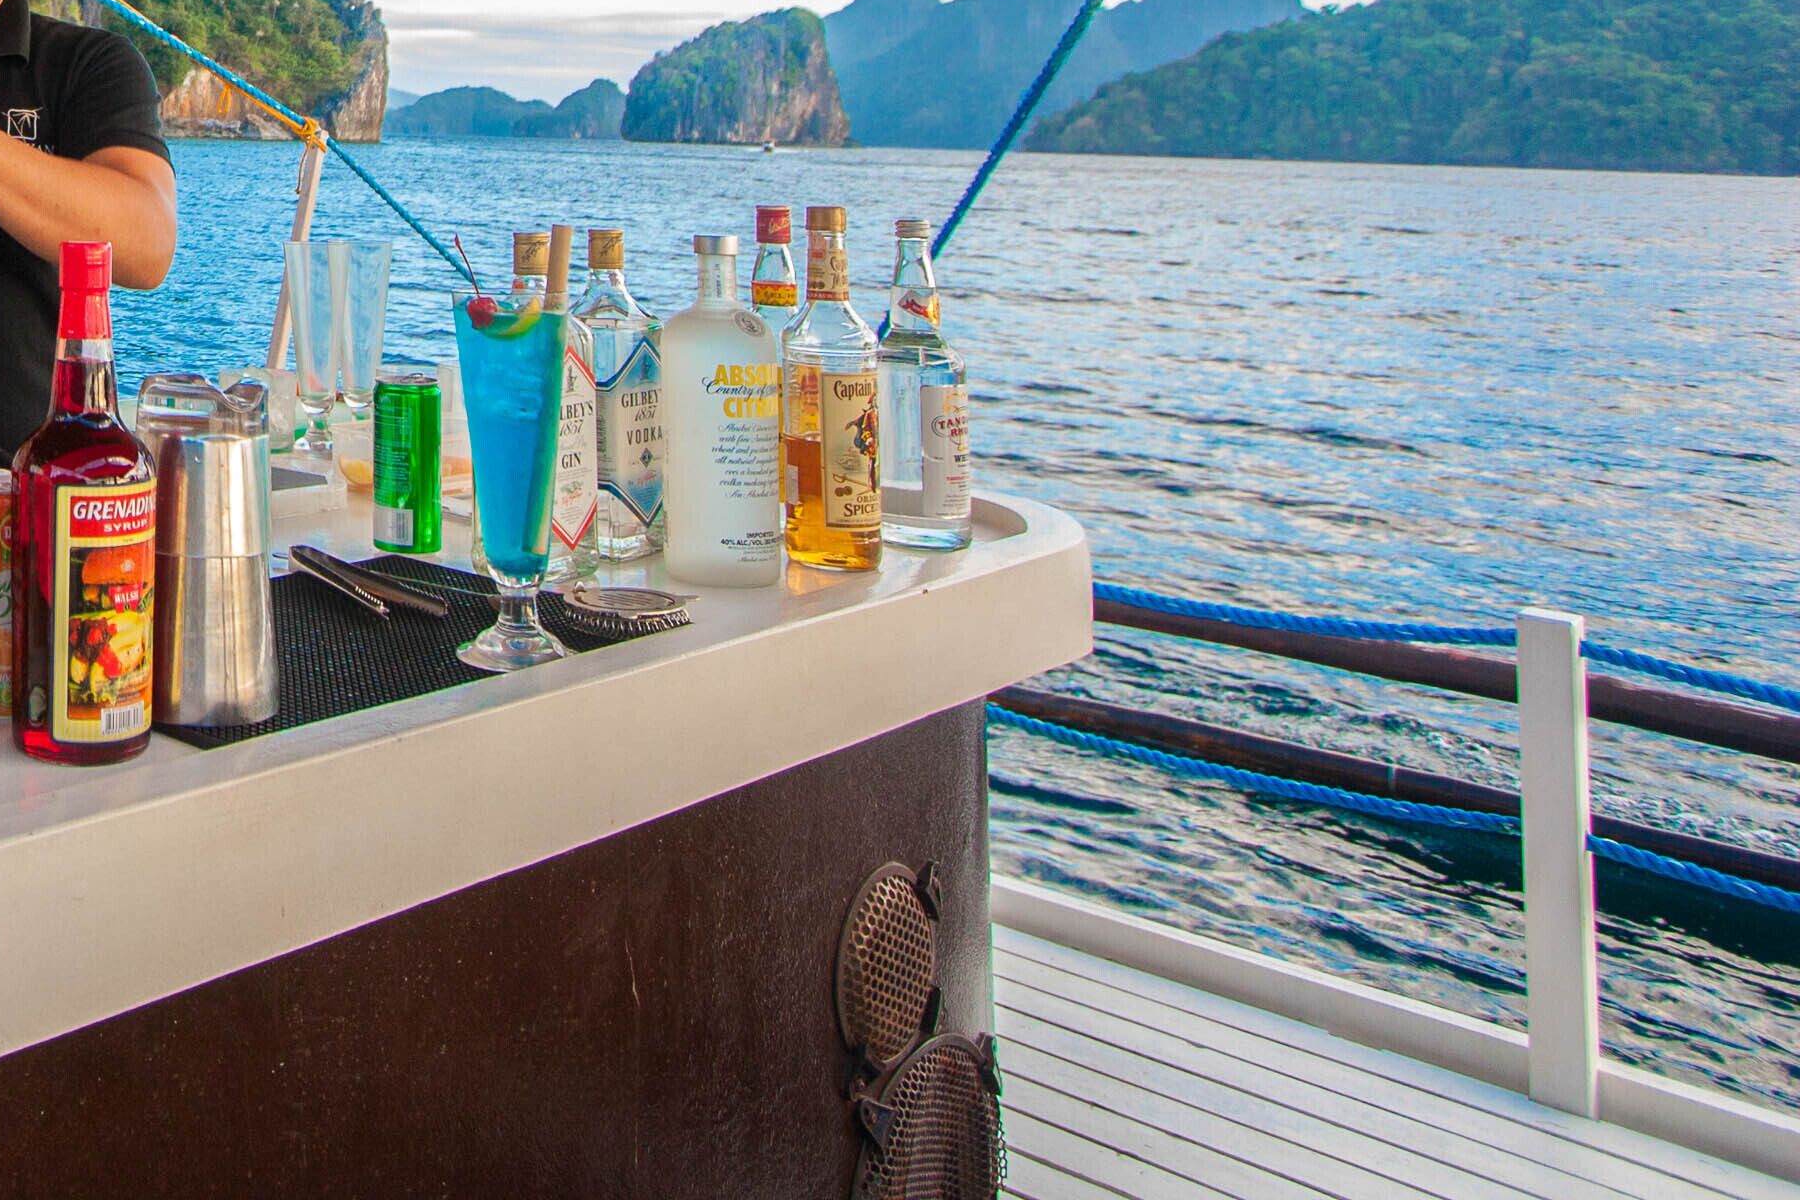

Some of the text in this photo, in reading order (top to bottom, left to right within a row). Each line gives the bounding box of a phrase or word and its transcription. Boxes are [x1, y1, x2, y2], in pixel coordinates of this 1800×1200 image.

[833, 379, 872, 401] Captain
[560, 399, 594, 421] LBEY'S
[626, 425, 663, 446] VODKA
[561, 451, 582, 470] GIN
[73, 495, 157, 521] GRENADIN
[843, 502, 880, 517] SPICE
[103, 518, 149, 533] SYRUP
[114, 590, 139, 604] WALSH
